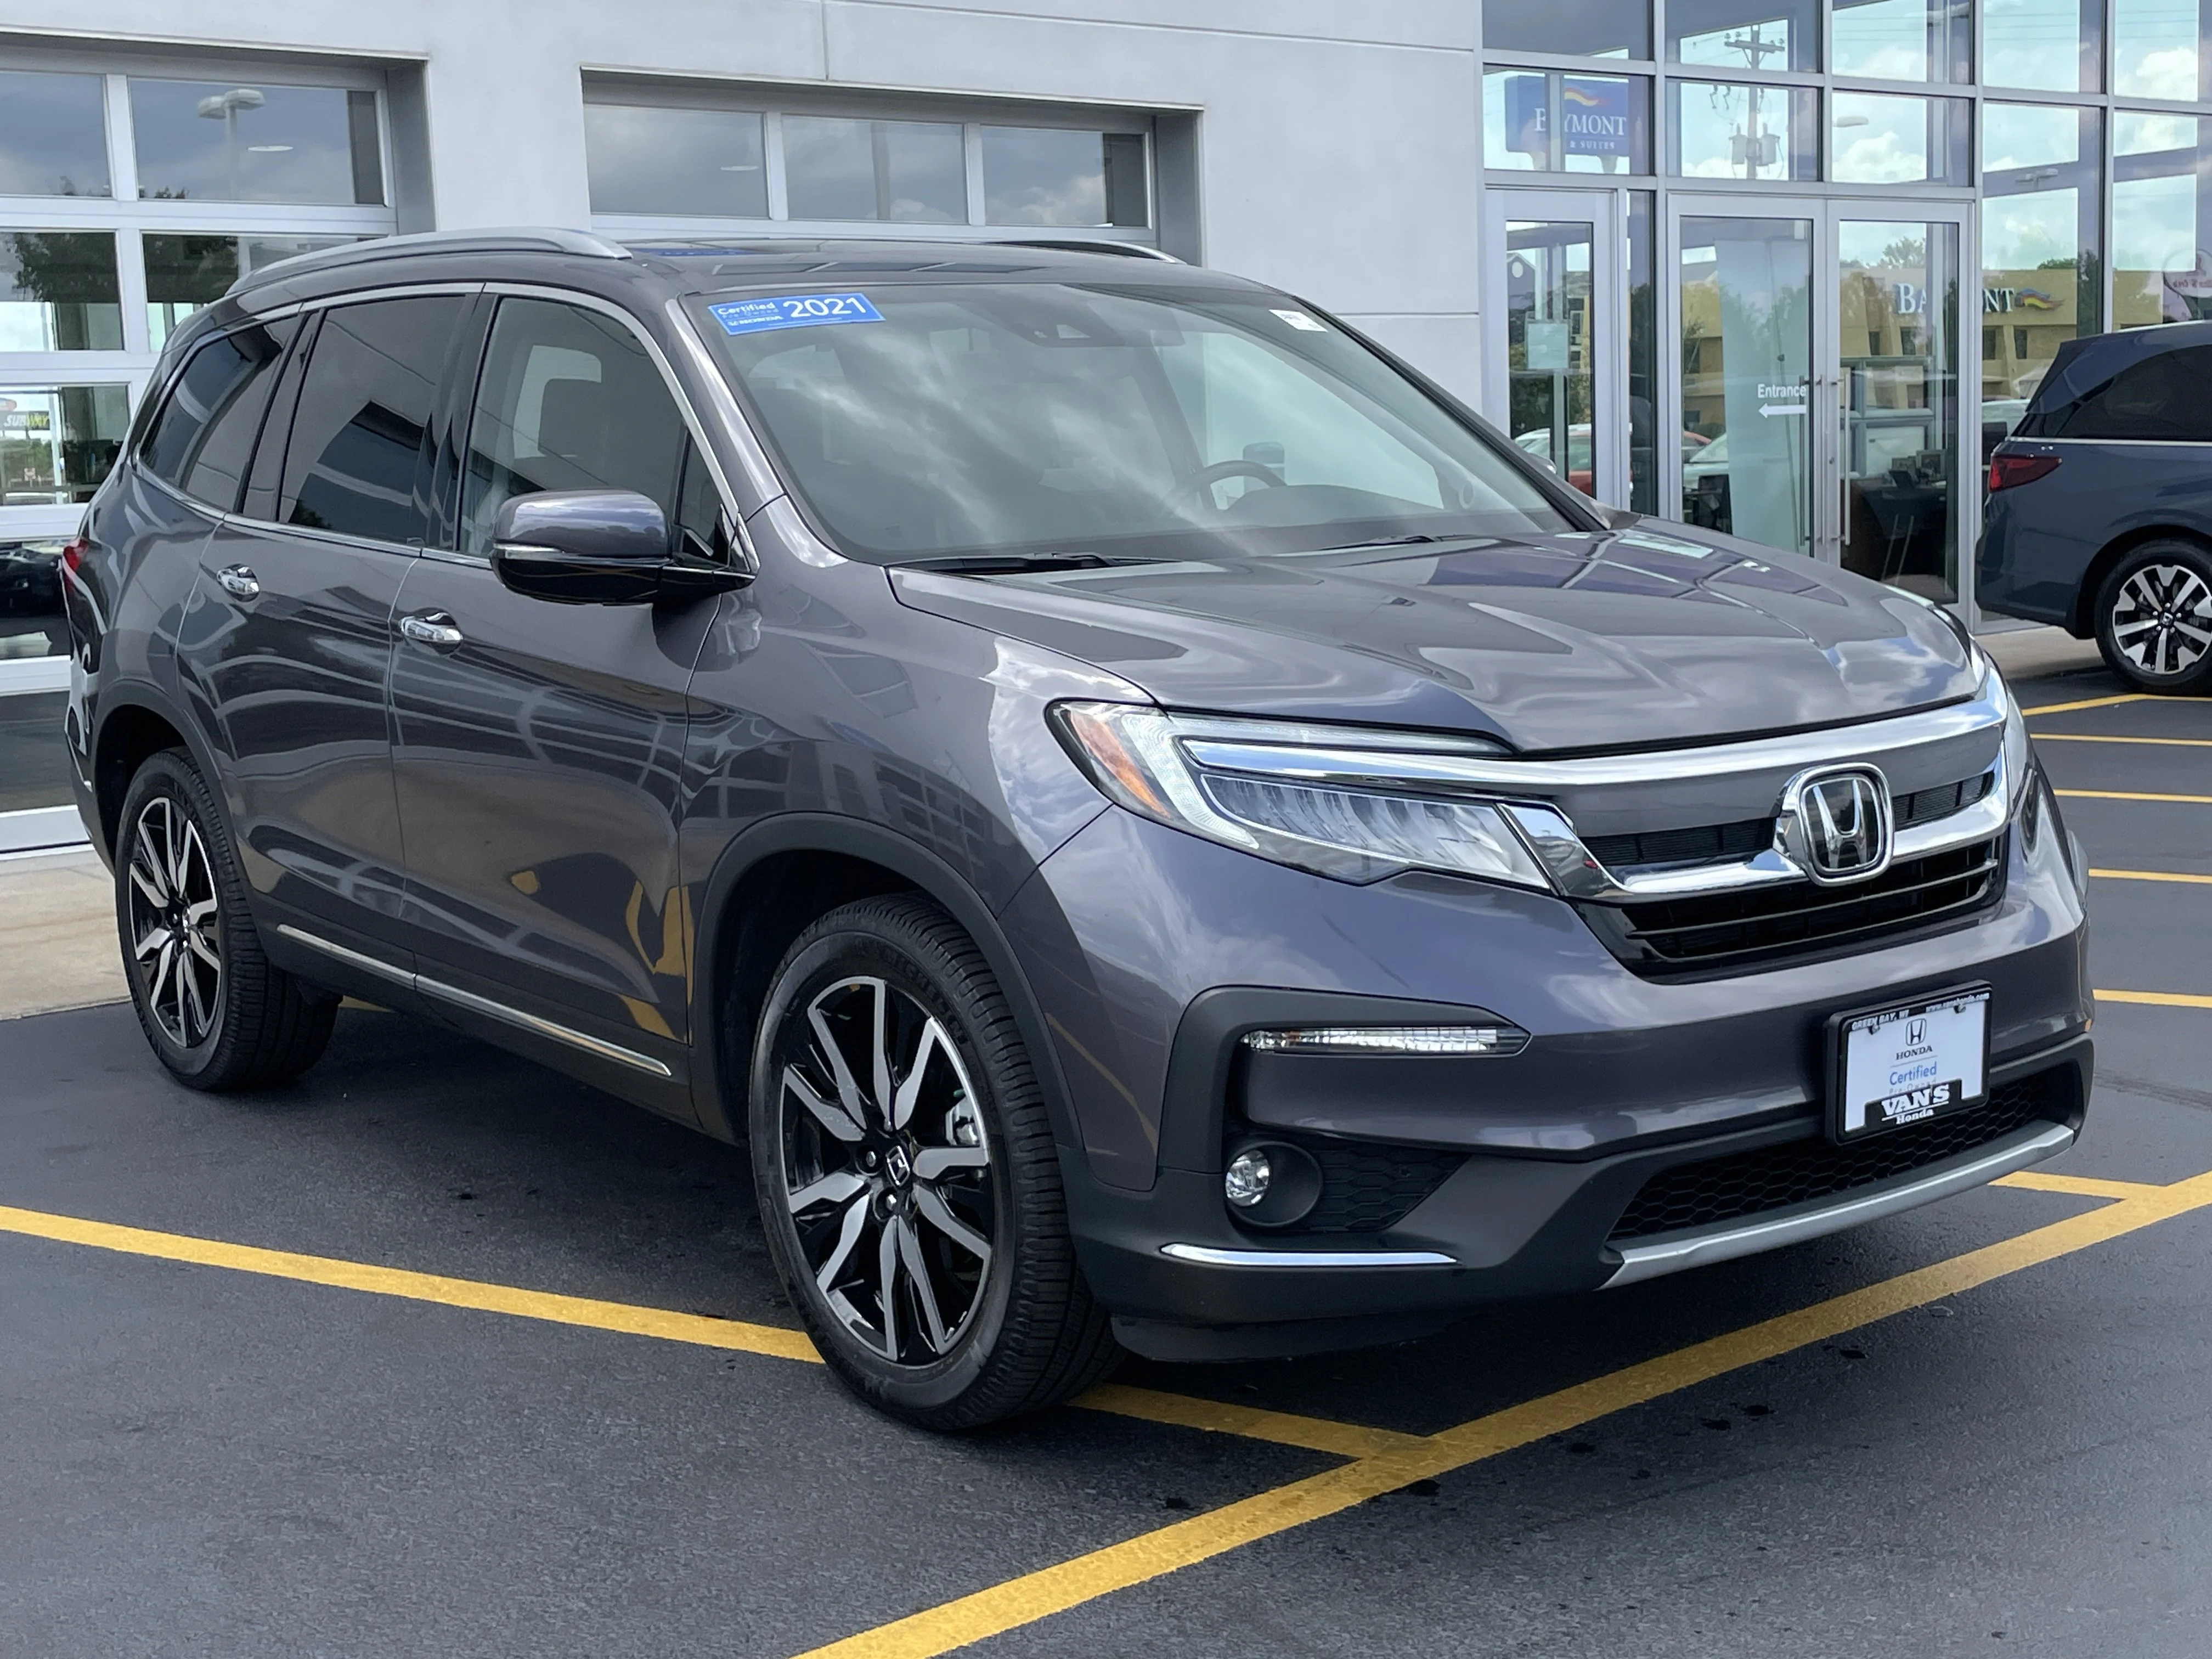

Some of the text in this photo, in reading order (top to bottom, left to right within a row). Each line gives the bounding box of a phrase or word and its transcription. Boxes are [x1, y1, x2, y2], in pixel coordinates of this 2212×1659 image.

[1534, 108, 1626, 136] BYMONT
[1580, 140, 1615, 149] SUITES
[718, 297, 866, 318] Certified 2021
[739, 315, 783, 325] HONDA
[1757, 383, 1807, 398] Entrance
[1852, 1015, 1878, 1031] GREEN
[1896, 1045, 1933, 1060] HONDA
[1889, 1061, 1937, 1086] Certified
[1896, 1108, 1934, 1125] Honda
